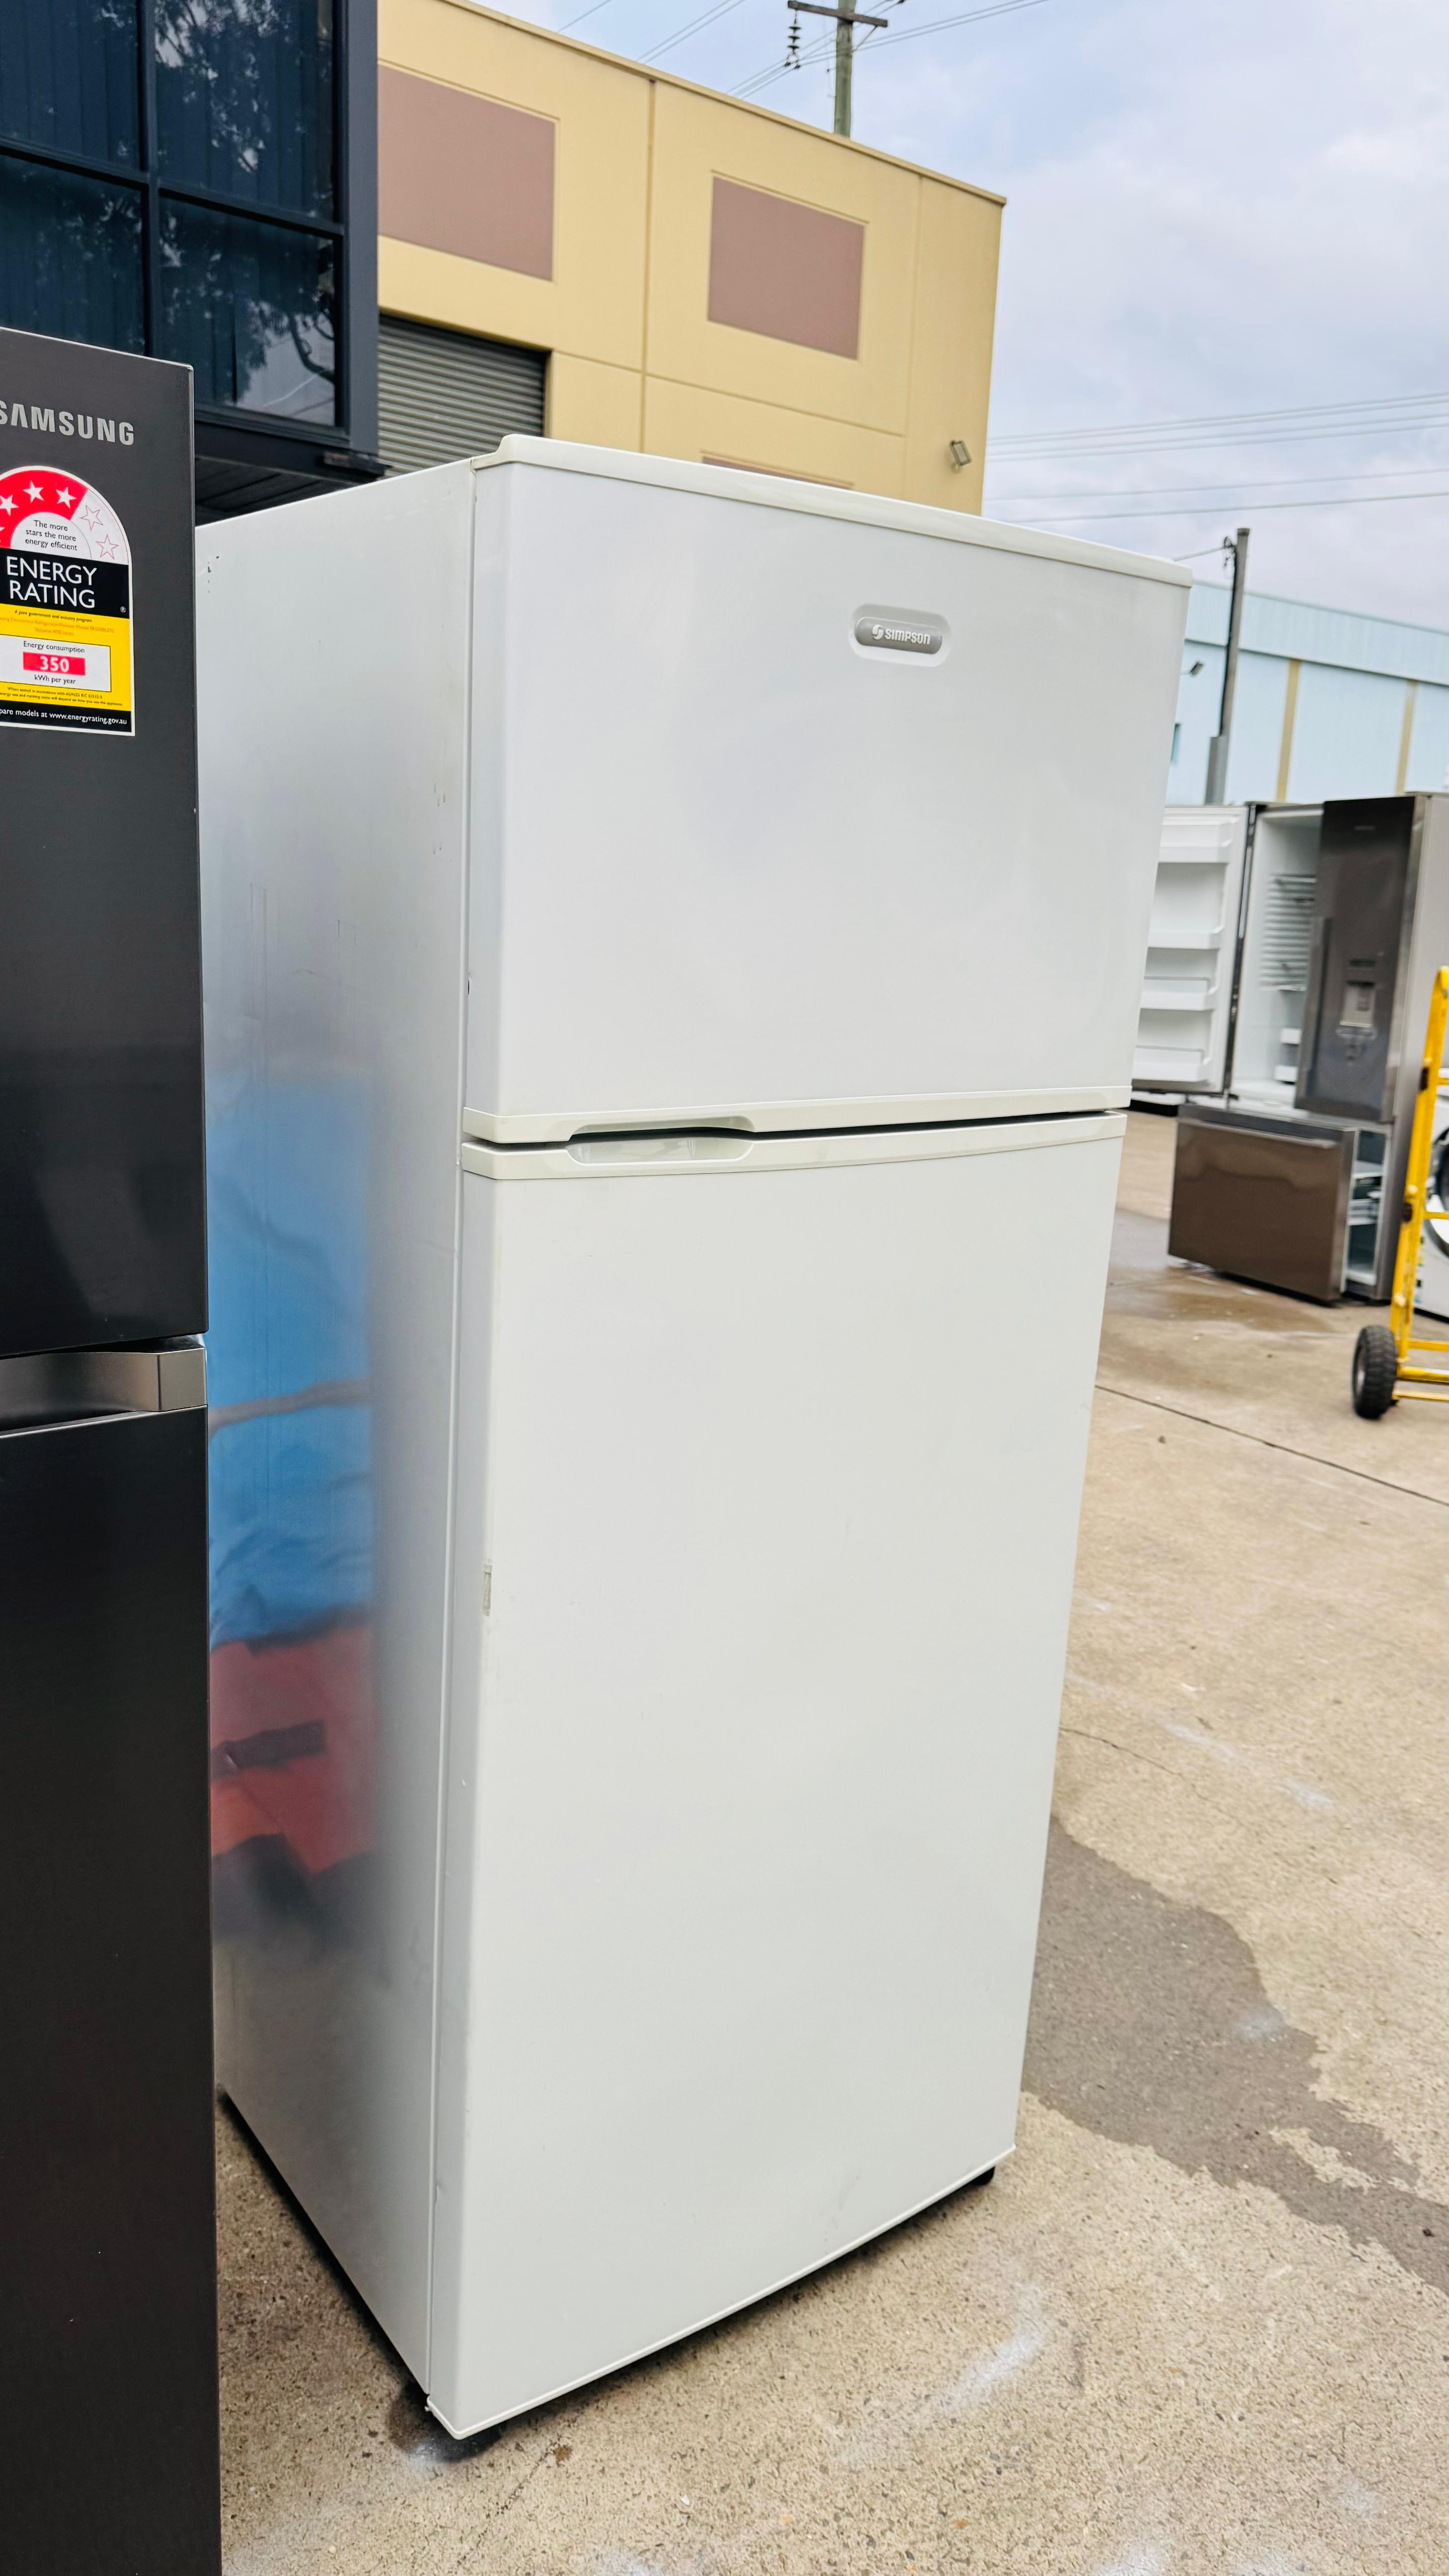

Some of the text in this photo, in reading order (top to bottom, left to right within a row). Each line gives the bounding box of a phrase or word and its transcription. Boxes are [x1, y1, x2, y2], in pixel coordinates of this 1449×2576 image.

[34, 519, 47, 528] The
[25, 538, 77, 551] energy efficient
[7, 556, 97, 586] ENERGY
[10, 580, 95, 609] RATING
[24, 640, 85, 653] Energy consumption
[40, 656, 69, 673] 350
[16, 709, 39, 717] models
[49, 713, 127, 725] www.energyrating.gov.au
